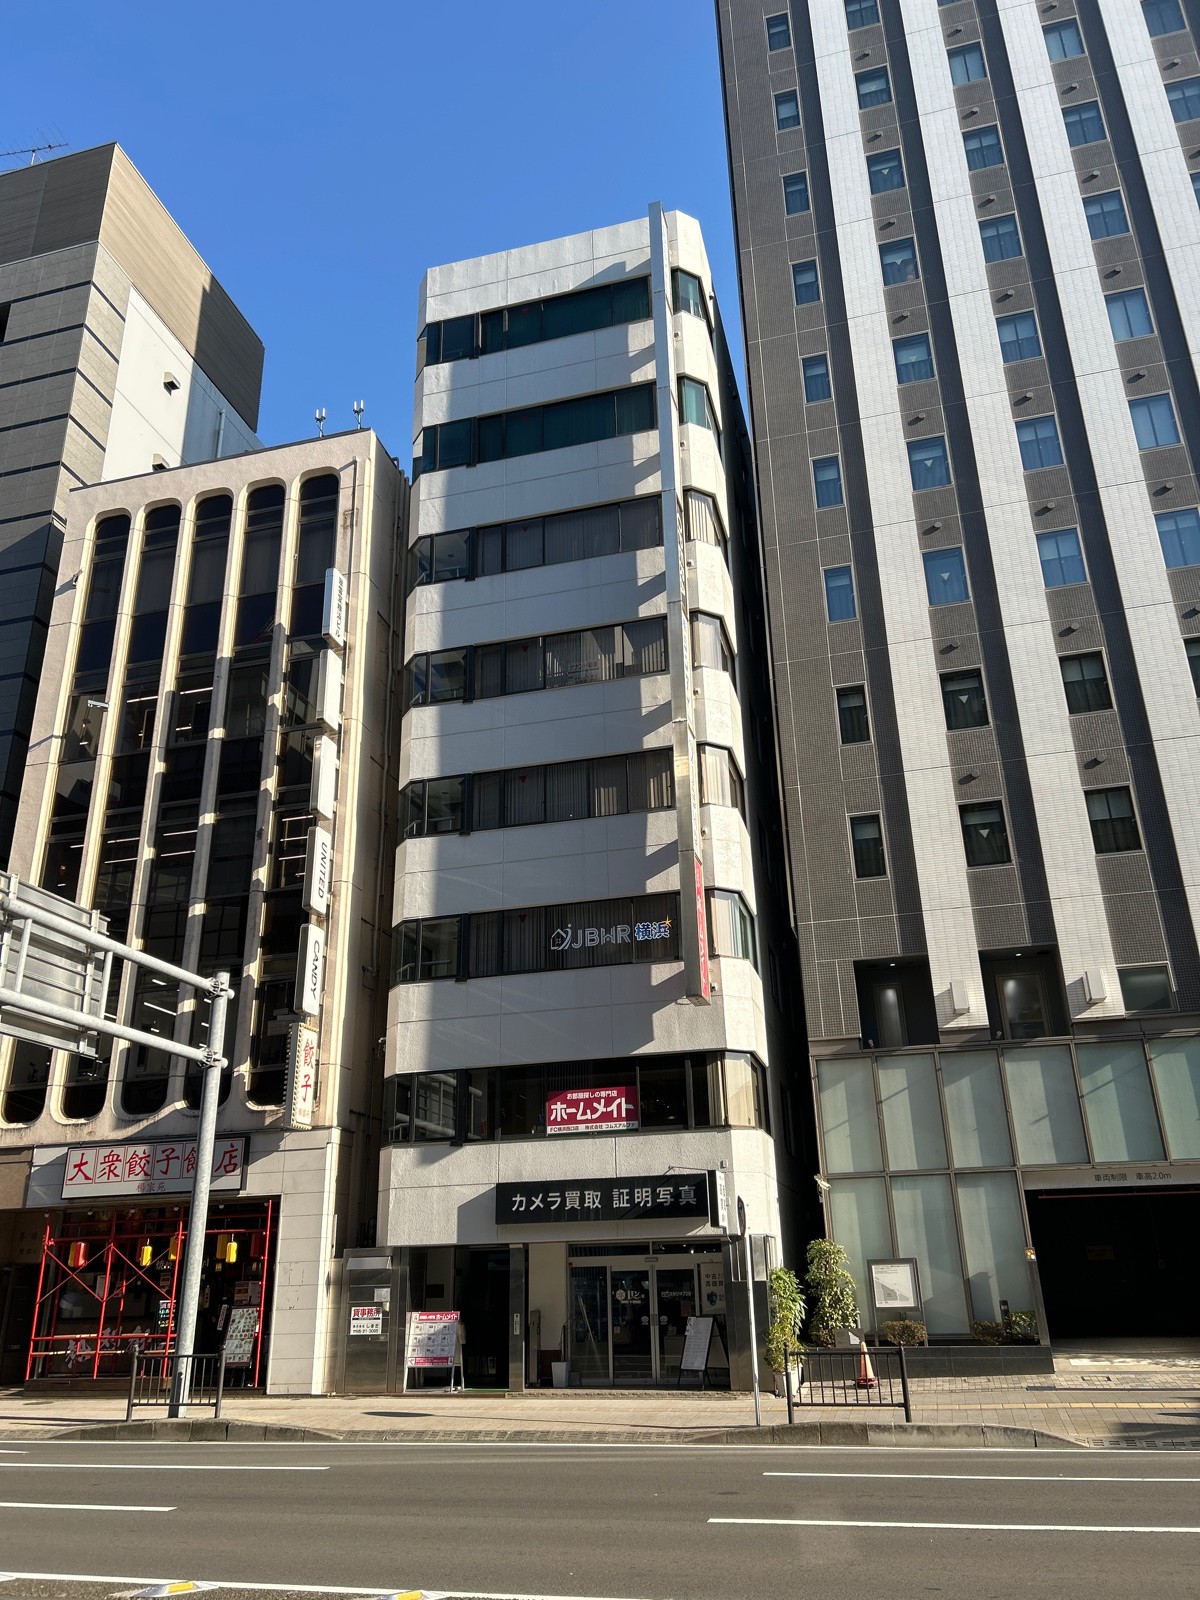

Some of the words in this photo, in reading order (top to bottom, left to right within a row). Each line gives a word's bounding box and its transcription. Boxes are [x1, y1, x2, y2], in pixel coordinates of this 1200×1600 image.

[317, 841, 328, 899] UNITED
[634, 920, 671, 941] 横浜
[309, 940, 321, 1001] CANDY
[300, 1039, 315, 1102] 餃子
[566, 1089, 618, 1100] お部屋探しの専門店
[550, 1097, 635, 1122] ホームメイト
[1094, 1173, 1128, 1182] 車両制限
[1136, 1172, 1172, 1181] 車高2.0m
[511, 1190, 602, 1212] カメラ買取
[612, 1185, 698, 1208] 証明写真
[353, 1307, 381, 1318] 貸事務所
